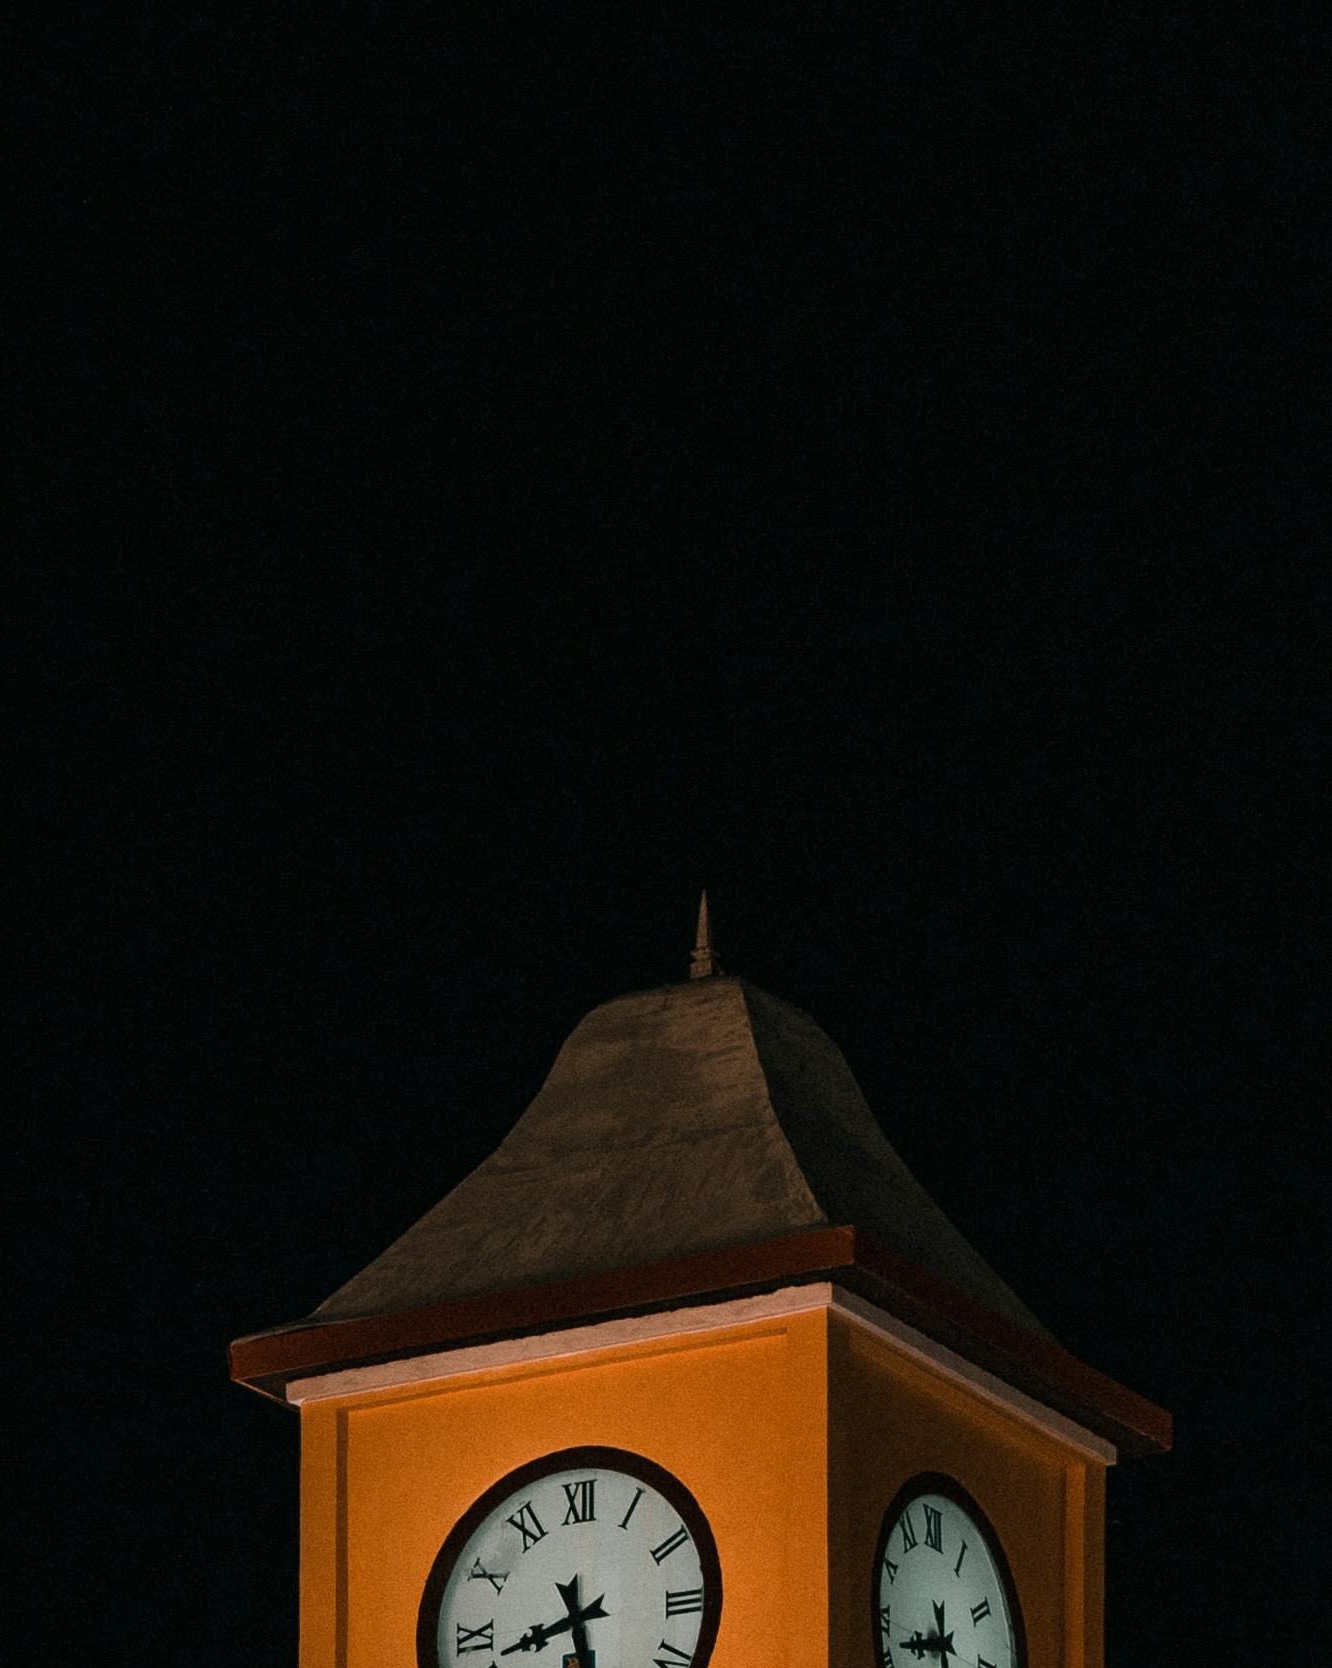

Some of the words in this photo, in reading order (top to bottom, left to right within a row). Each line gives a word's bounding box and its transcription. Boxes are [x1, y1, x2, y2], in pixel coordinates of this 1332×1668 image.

[561, 1478, 597, 1526] XII
[505, 1501, 549, 1553] XI
[649, 1524, 689, 1566] II
[467, 1557, 510, 1596] X
[665, 1588, 703, 1620] III
[457, 1618, 494, 1658] IX
